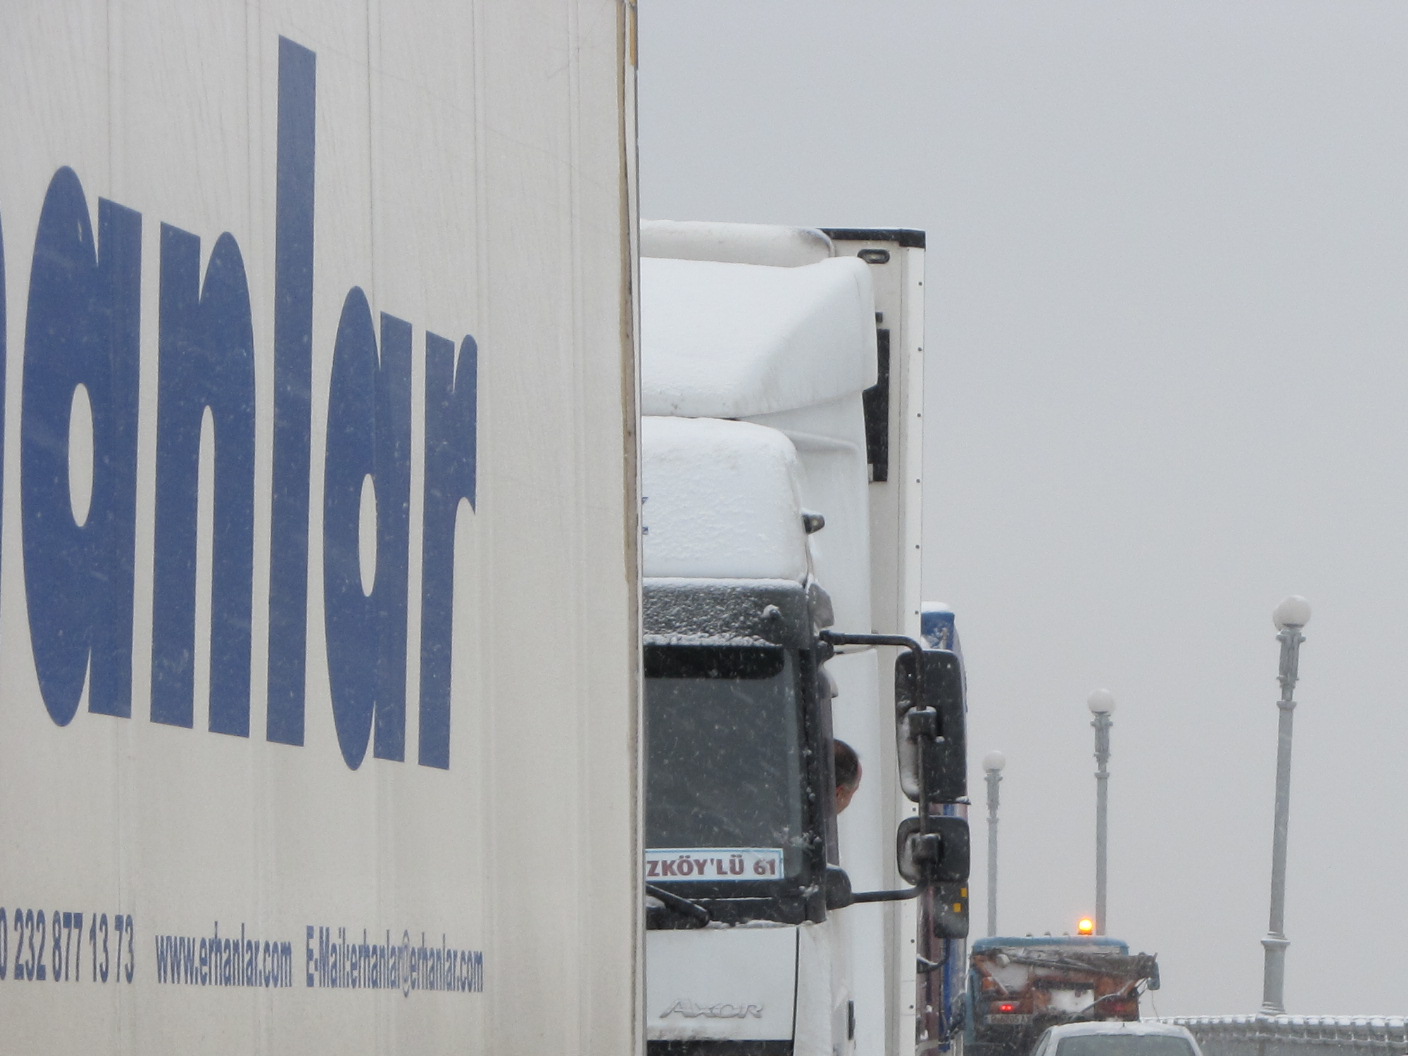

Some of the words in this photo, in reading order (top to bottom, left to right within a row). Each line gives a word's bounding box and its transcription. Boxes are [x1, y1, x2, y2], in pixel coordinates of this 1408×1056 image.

[0, 35, 478, 771] anlar
[752, 858, 777, 876] 61
[14, 908, 47, 981] 232
[52, 909, 84, 982] 877
[89, 912, 110, 983] 13
[114, 913, 135, 984] 73
[155, 921, 292, 988] www.erhanlar.com
